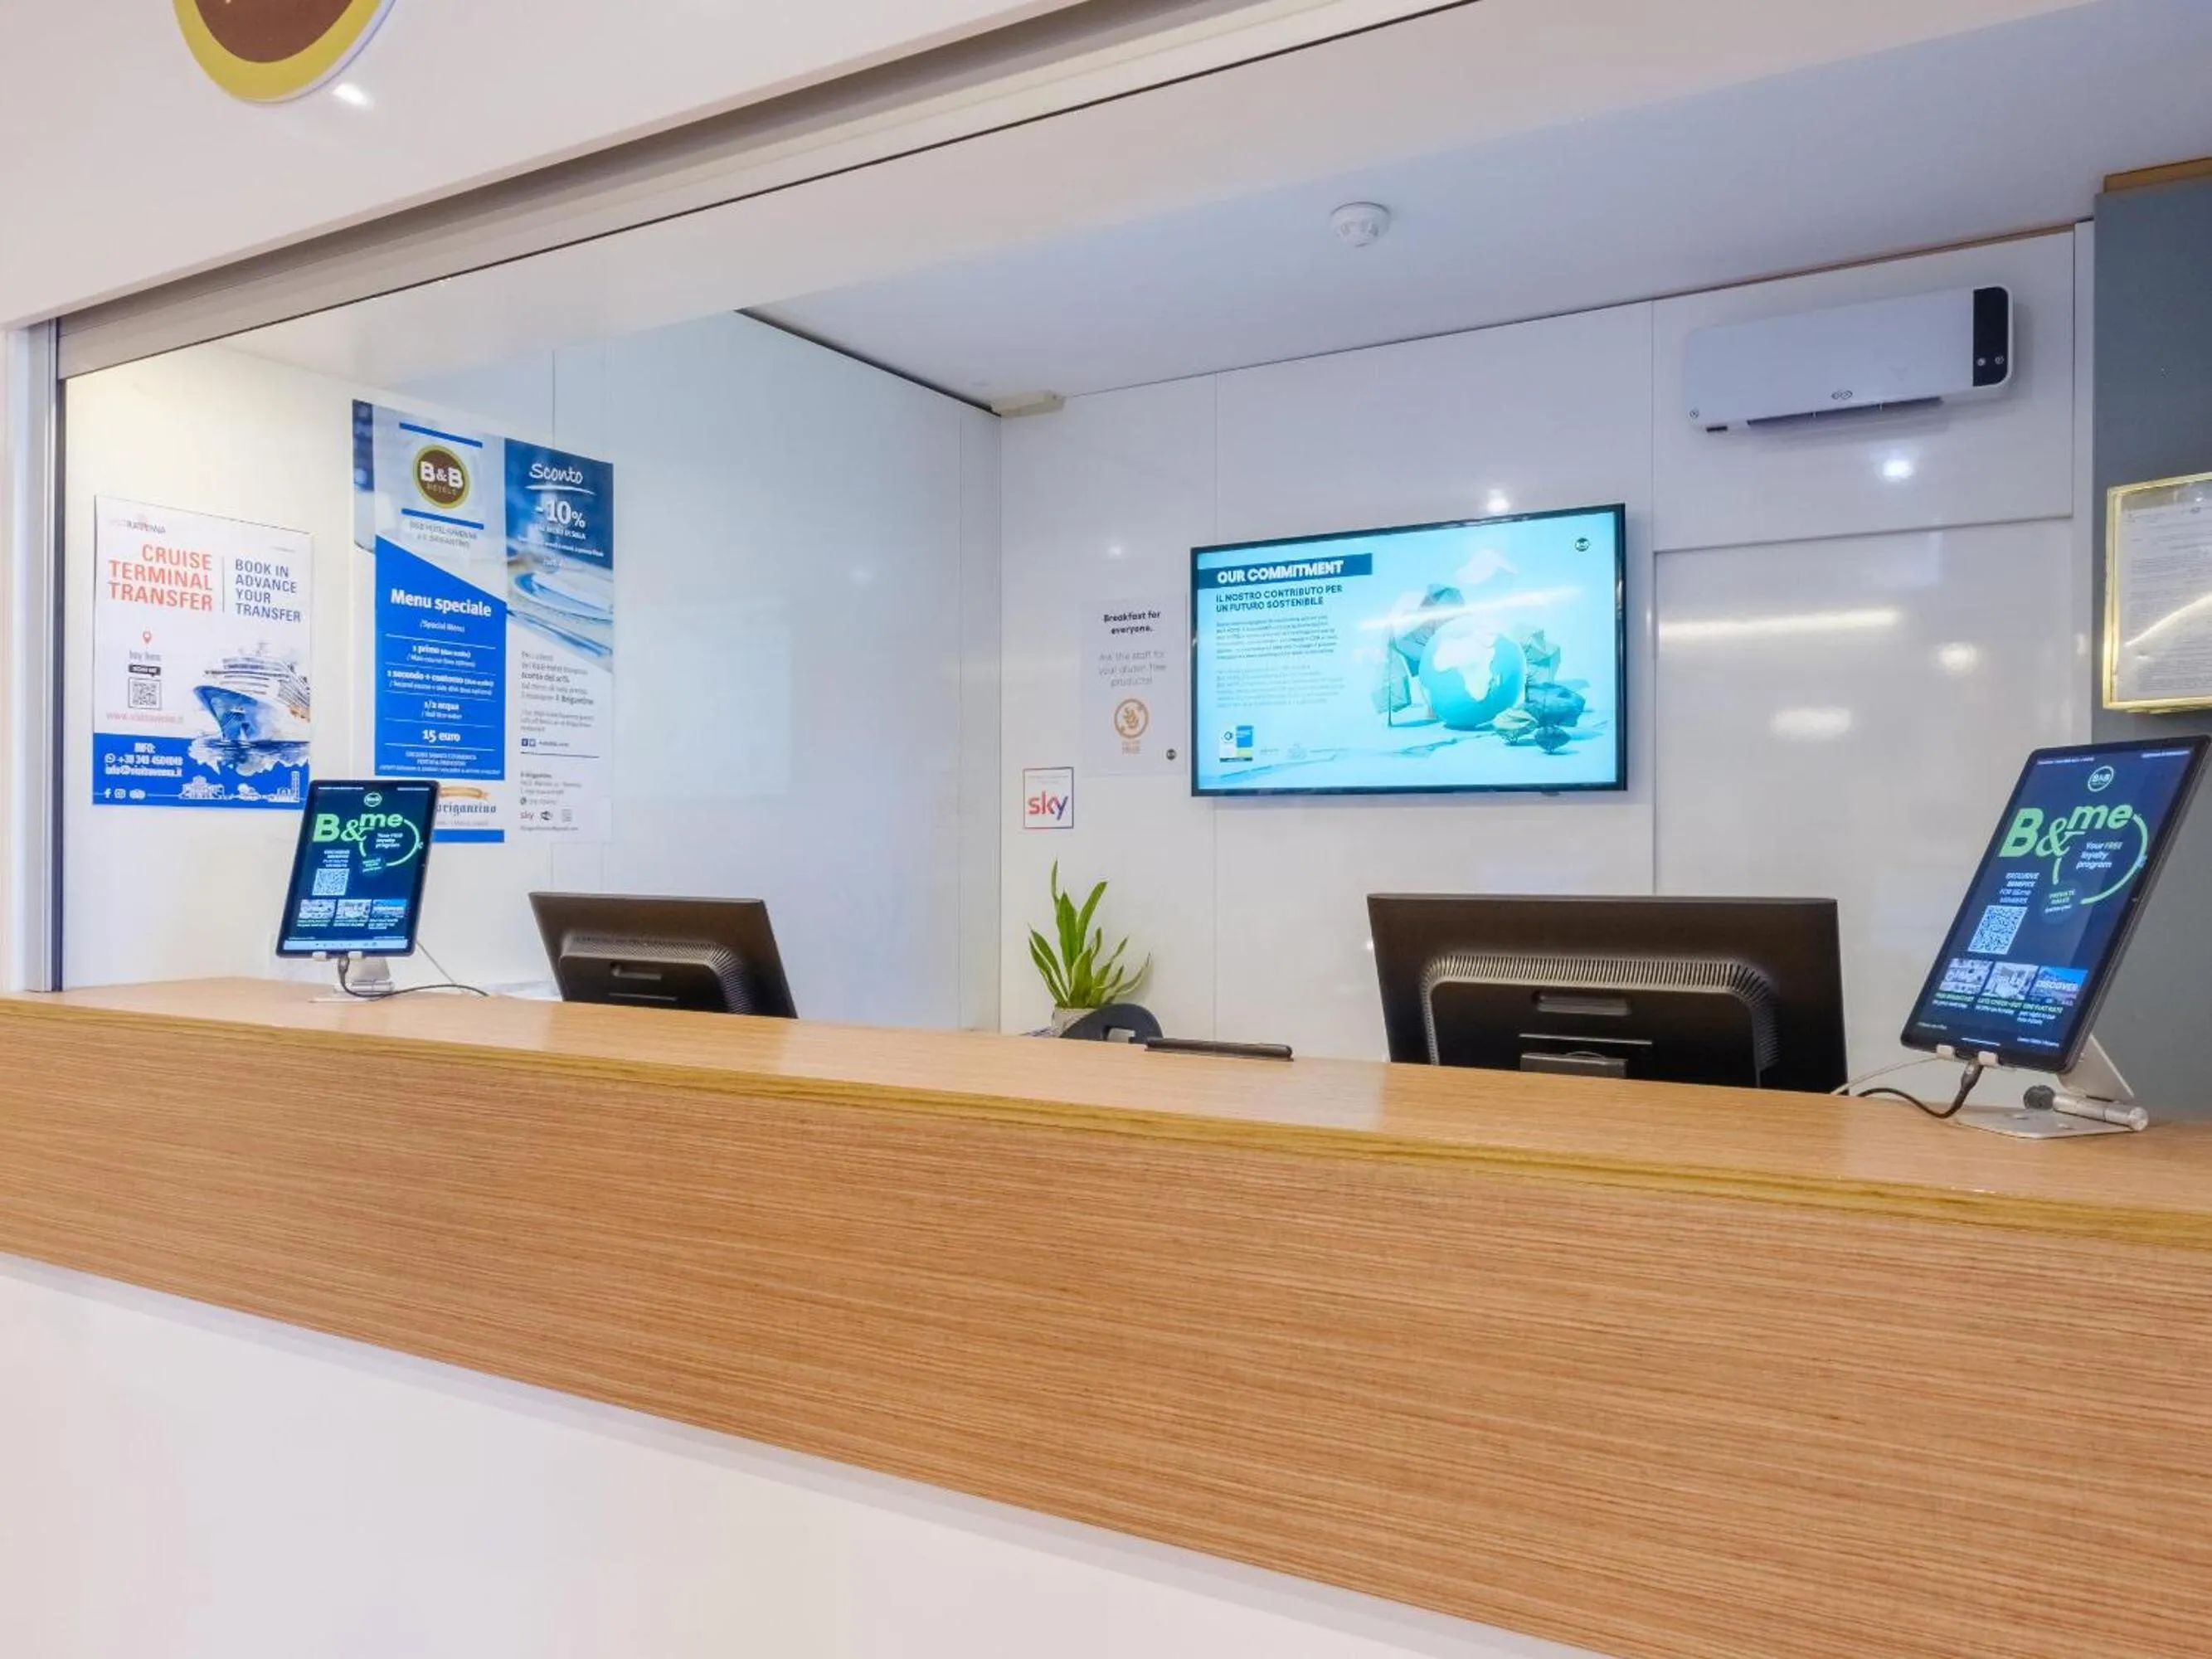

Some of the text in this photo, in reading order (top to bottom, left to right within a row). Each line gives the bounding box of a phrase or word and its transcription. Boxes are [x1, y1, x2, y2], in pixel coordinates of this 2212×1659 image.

[421, 461, 464, 489] B&B
[529, 464, 583, 484] Sconto
[142, 543, 213, 572] CRUISE
[108, 559, 213, 591] TERMINAL
[235, 558, 289, 578] BOOK IN
[1217, 560, 1344, 584] OUR COMMITMENT
[235, 574, 297, 593] ADVANCE
[1216, 584, 1343, 603] IL NOSTRO CONTRIBUTO PER
[108, 581, 212, 611] TRANSFER
[236, 588, 271, 604] YOUR
[391, 588, 492, 617] Menu speciale
[1216, 596, 1324, 612] UN FUTURO SOSTENIBILE
[236, 602, 301, 622] TRANSFER
[1103, 610, 1162, 622] Breakfast for
[1111, 625, 1154, 635] everyone.
[422, 729, 461, 743] 15 euro
[1028, 791, 1069, 820] sky
[2075, 861, 2112, 870] program
